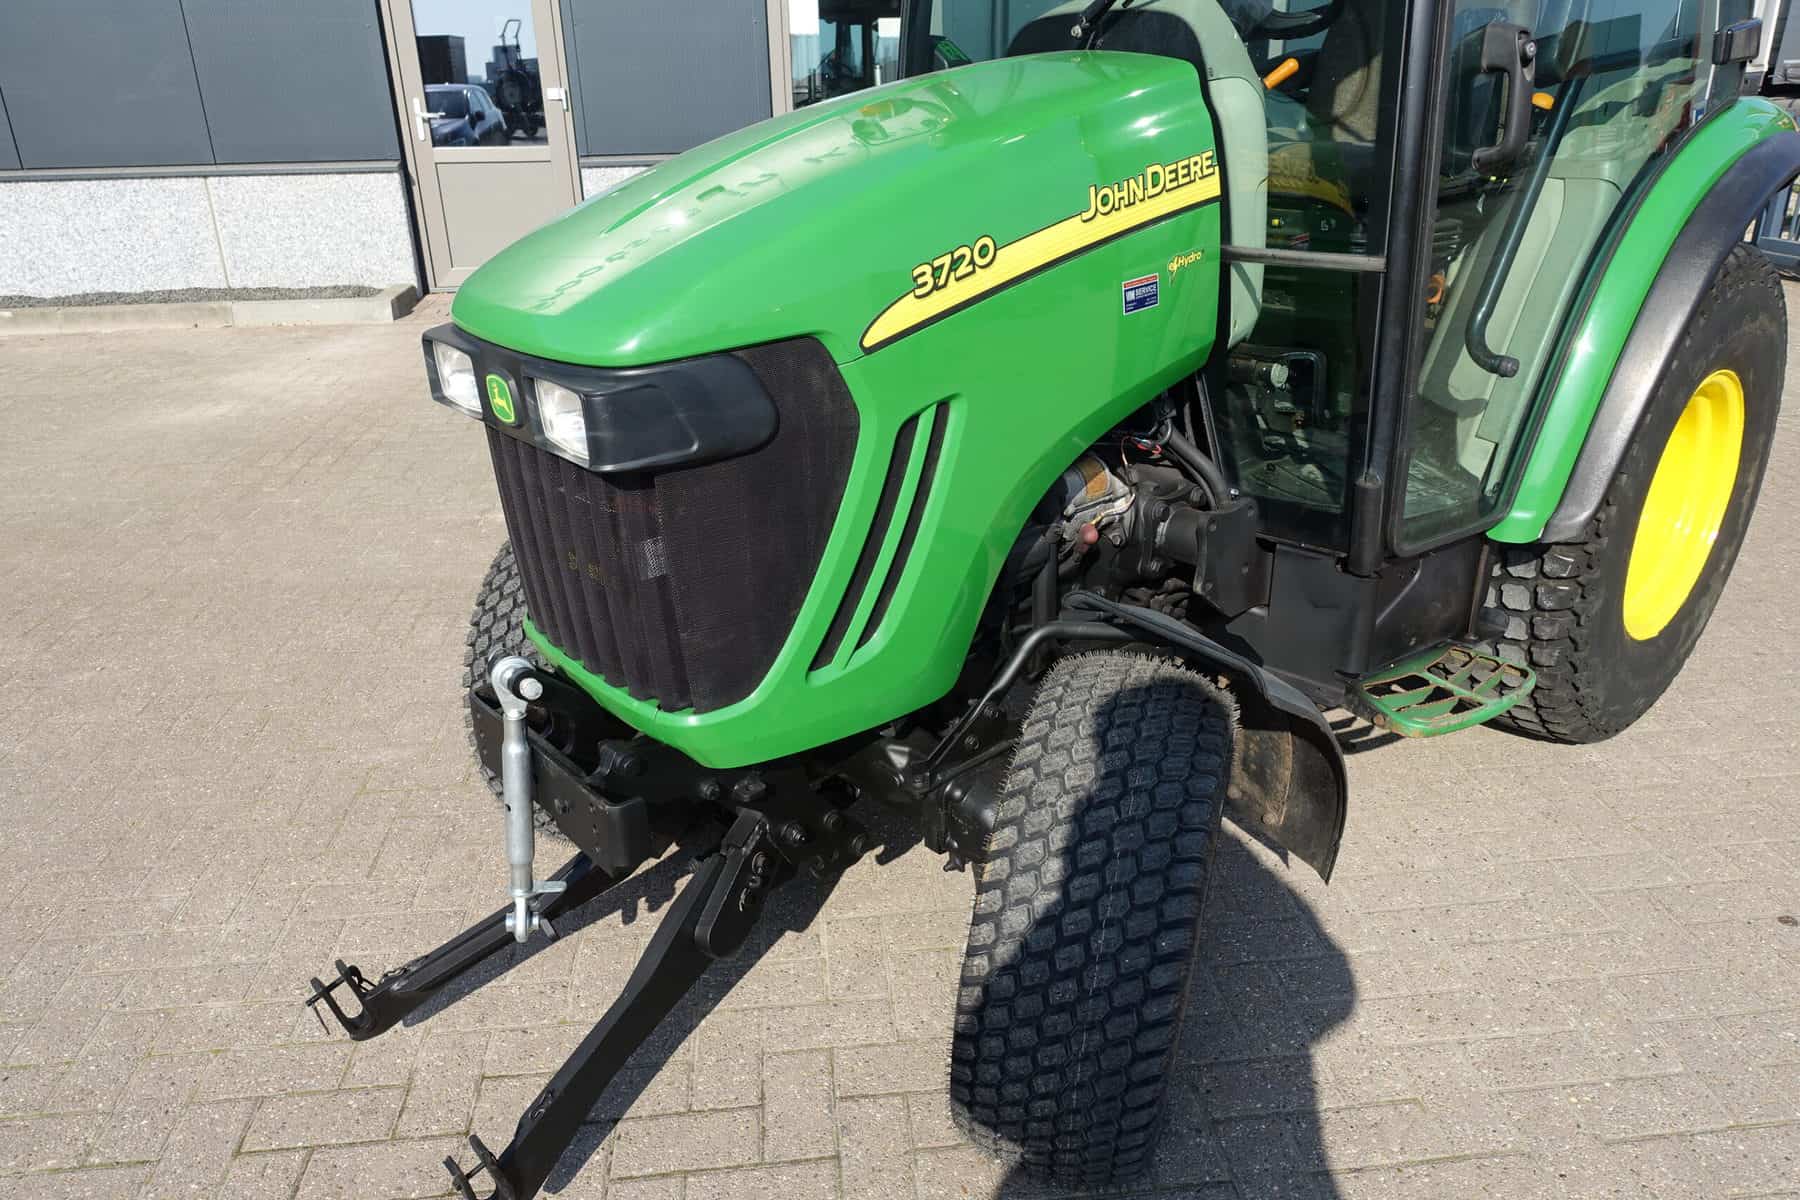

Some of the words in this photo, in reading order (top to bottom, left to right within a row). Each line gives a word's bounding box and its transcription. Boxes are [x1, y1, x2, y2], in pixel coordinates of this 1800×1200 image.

[1080, 173, 1145, 223] JOHN
[1145, 149, 1216, 199] DEERE
[912, 235, 997, 299] 3720
